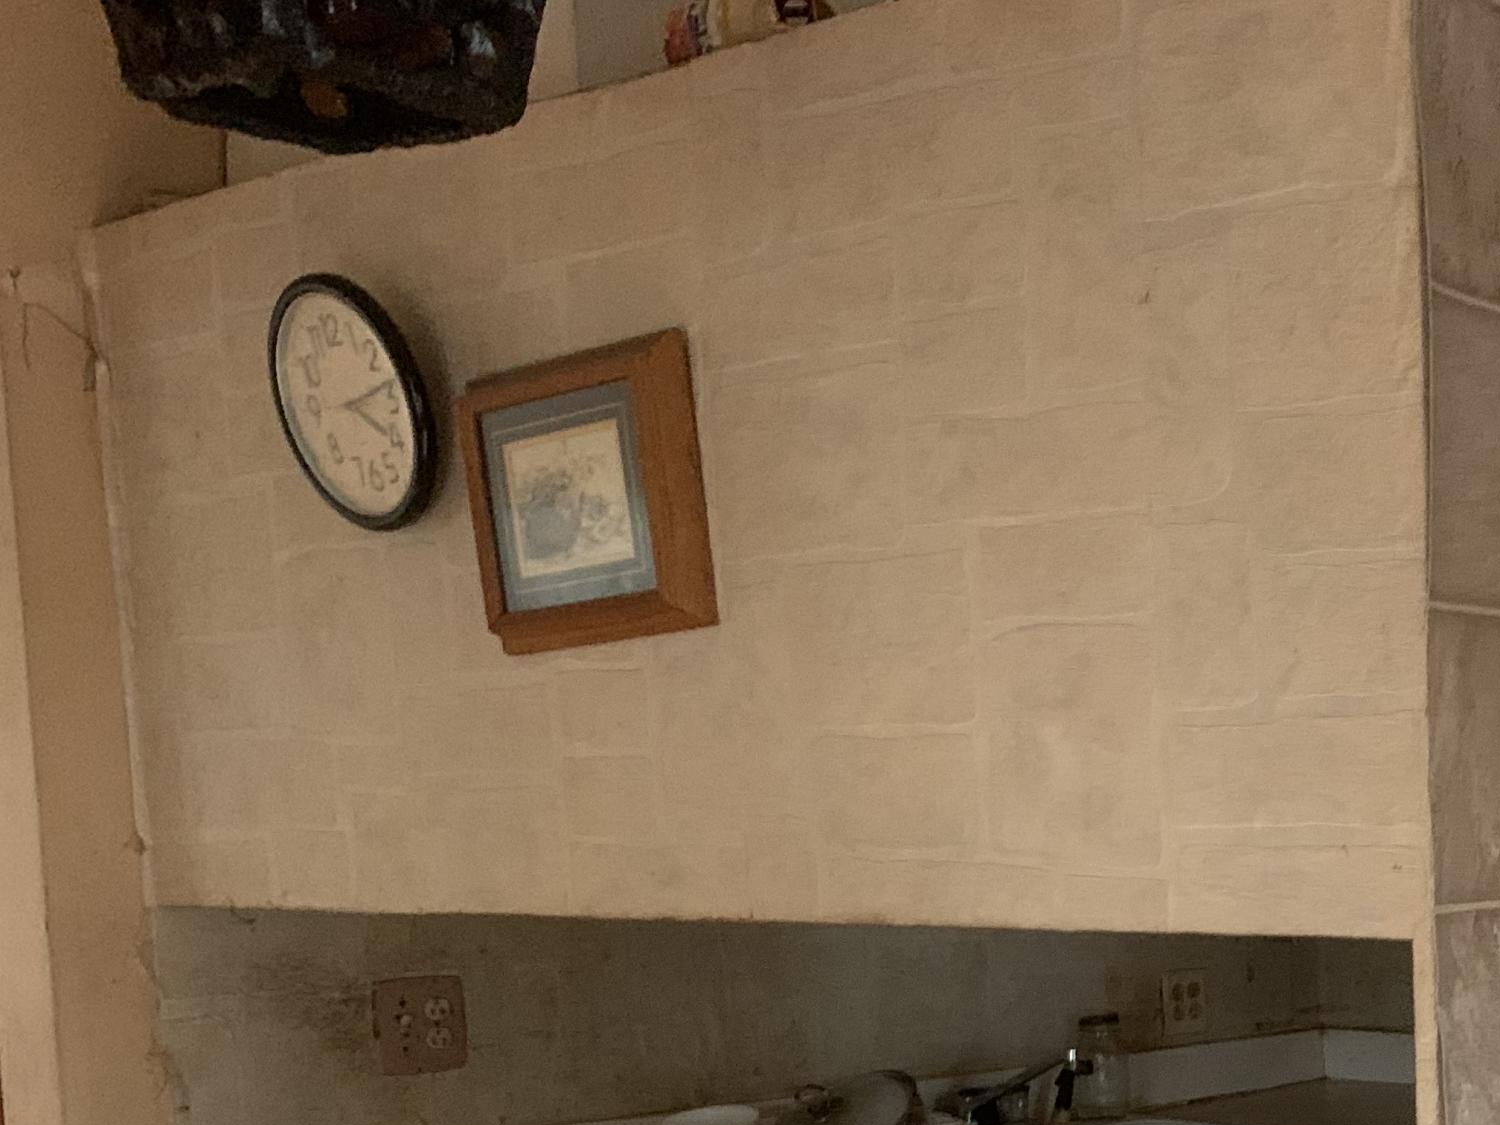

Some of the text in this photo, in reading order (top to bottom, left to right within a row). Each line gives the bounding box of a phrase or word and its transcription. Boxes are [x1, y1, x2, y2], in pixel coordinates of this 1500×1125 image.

[307, 325, 326, 357] 11
[318, 313, 343, 348] 12
[346, 322, 359, 354] 1
[365, 338, 381, 370] 2
[299, 354, 322, 388] 10
[306, 394, 322, 427] 9
[328, 432, 344, 465] 8
[389, 422, 404, 452] 4
[351, 456, 366, 487] 7
[369, 460, 384, 492] 6
[382, 452, 400, 484] 5
